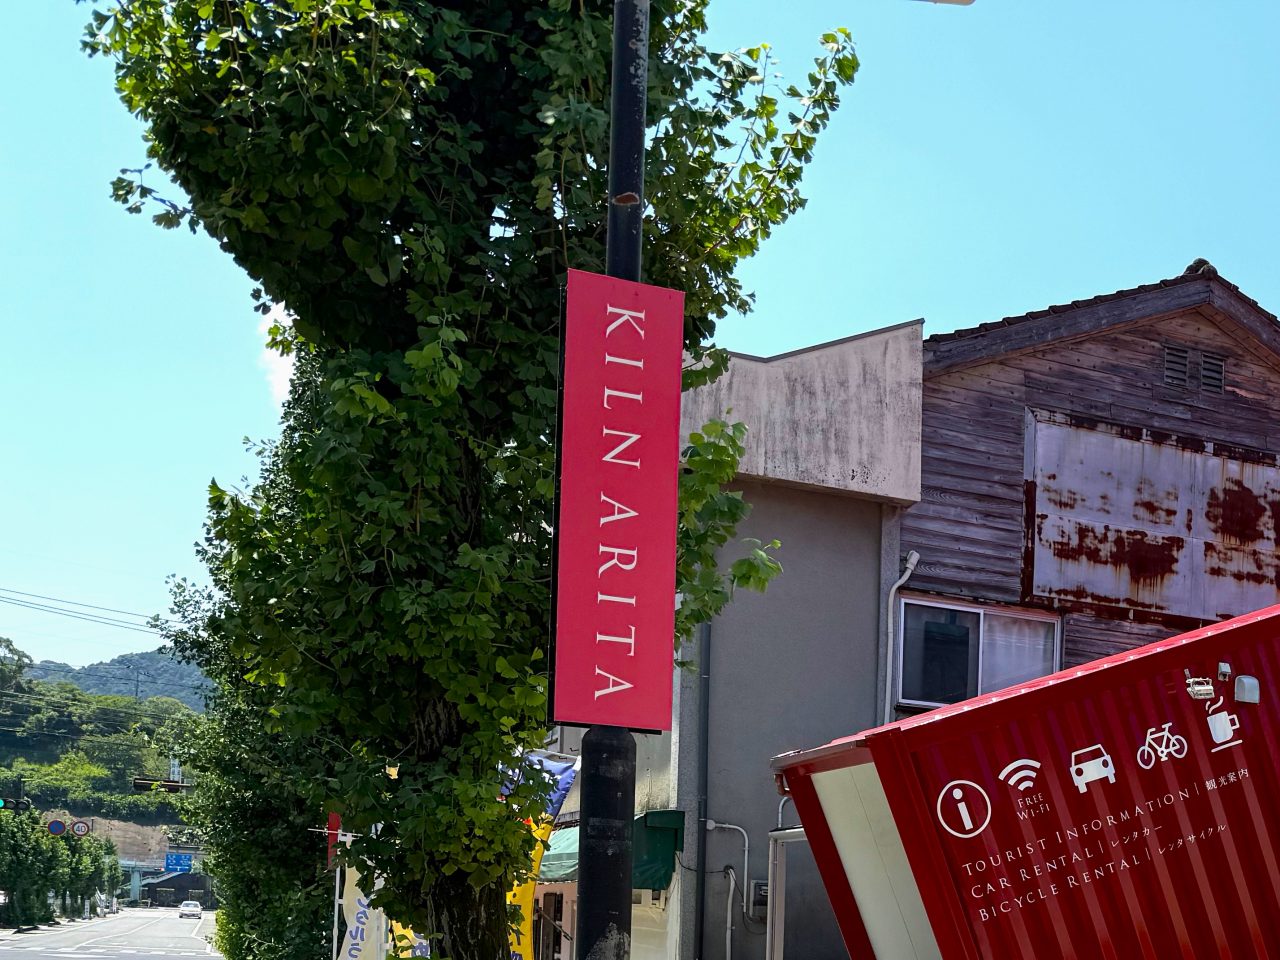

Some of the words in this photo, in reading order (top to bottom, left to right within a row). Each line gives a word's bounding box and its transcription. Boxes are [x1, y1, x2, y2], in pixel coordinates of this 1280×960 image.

[601, 303, 646, 469] KILN
[594, 491, 640, 702] ARITA
[962, 838, 1046, 876] TOURIST
[1056, 788, 1190, 843] INFORMATION
[1205, 768, 1249, 791] 観光案内
[1017, 792, 1044, 808] FREE
[971, 877, 1012, 898] CAR
[1020, 848, 1094, 882] RENTAL
[1111, 825, 1163, 848] レンタカー
[978, 883, 1059, 922] BICYCLE
[1067, 855, 1140, 888] RENTAL
[1158, 824, 1227, 855] レンタサイクル
